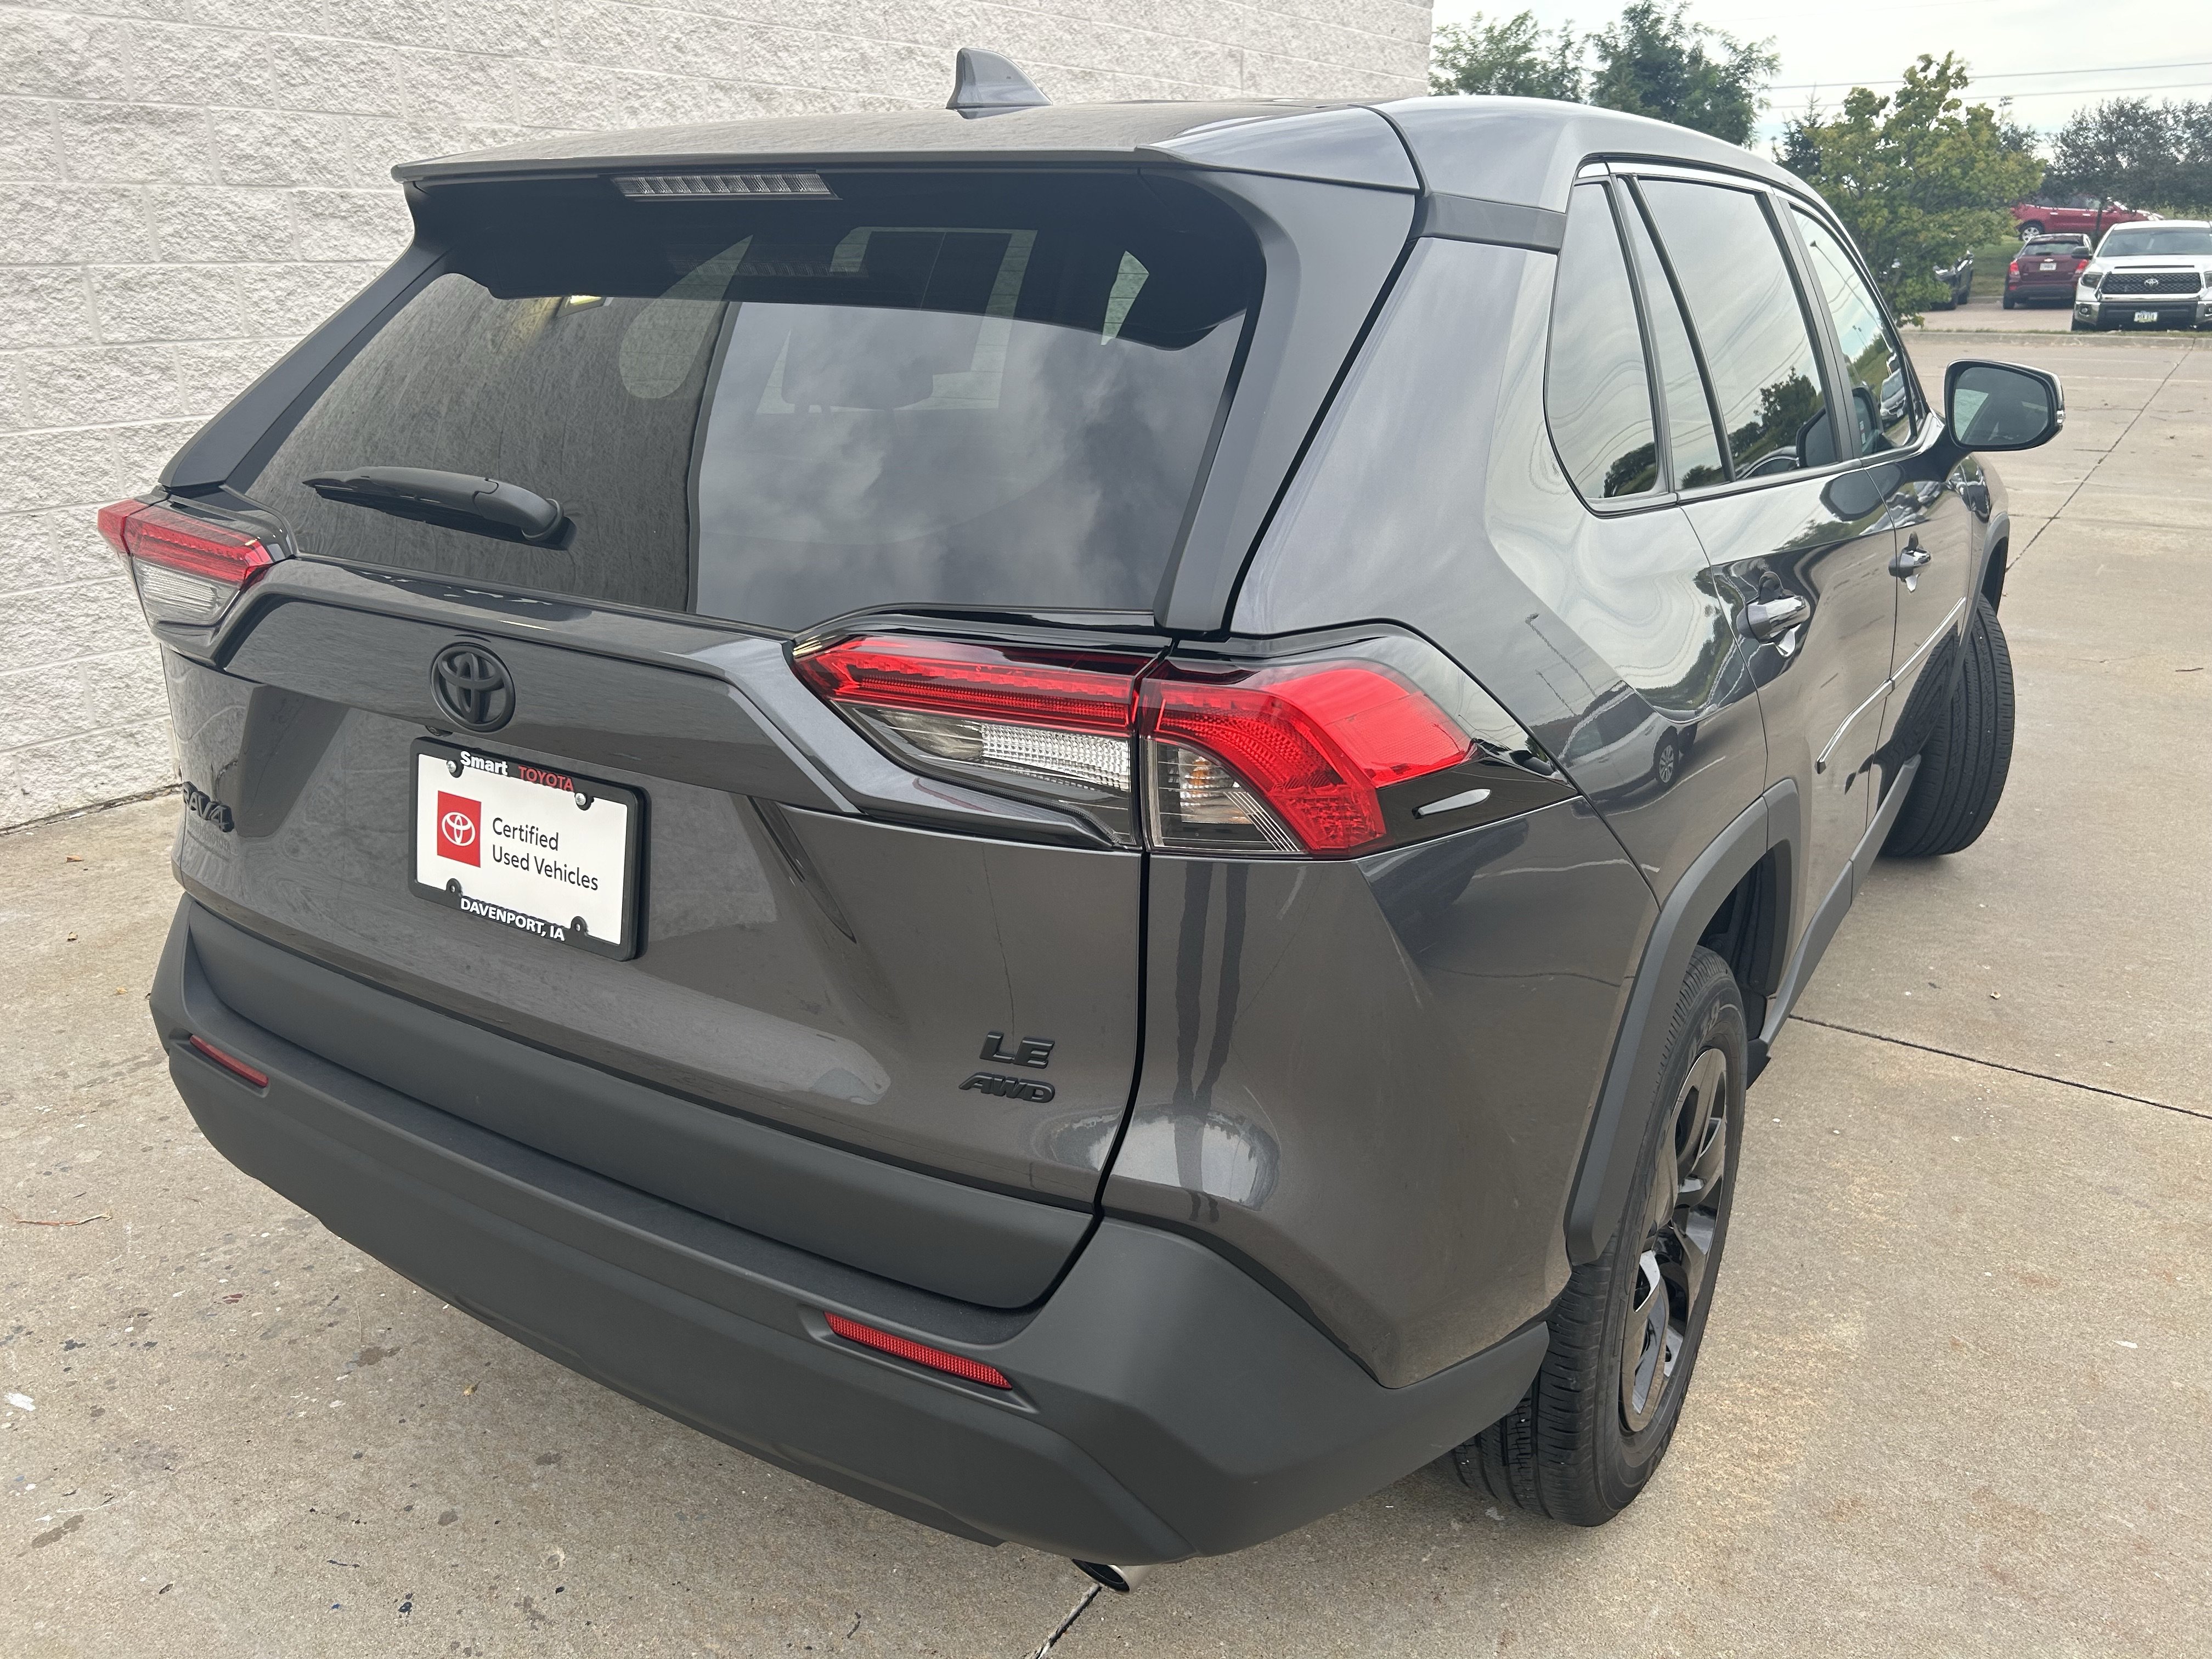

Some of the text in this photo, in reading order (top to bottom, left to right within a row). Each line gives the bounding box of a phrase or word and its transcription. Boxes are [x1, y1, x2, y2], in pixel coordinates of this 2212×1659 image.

[460, 751, 574, 791] Smart TOYOTA
[493, 817, 558, 851] Certified
[493, 844, 599, 891] Used Vehicles
[460, 898, 565, 941] DAVENPORT, IA
[979, 1030, 1055, 1069] LE
[958, 1071, 1056, 1104] AWD
